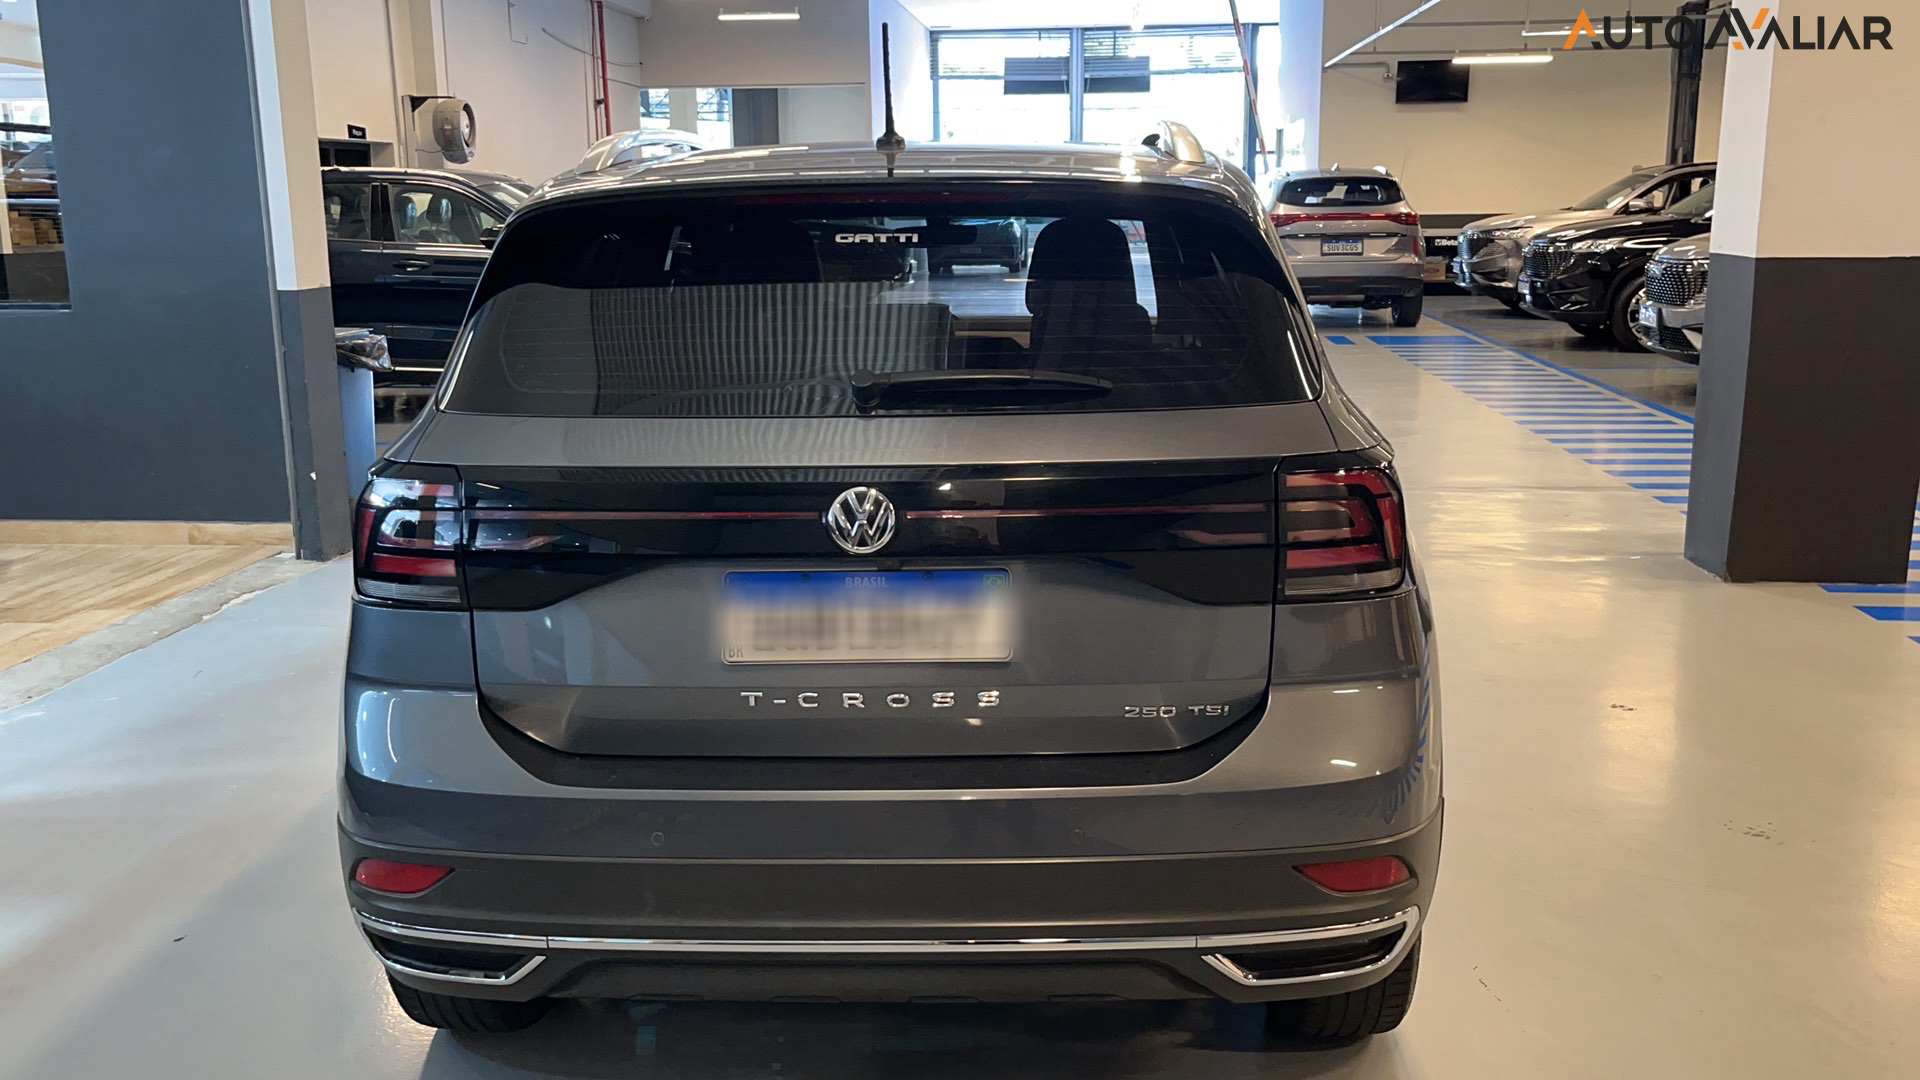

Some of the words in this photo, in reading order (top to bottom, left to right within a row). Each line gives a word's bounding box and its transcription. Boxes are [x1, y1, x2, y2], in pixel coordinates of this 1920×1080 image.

[835, 233, 919, 243] GATTI
[845, 576, 889, 588] BRASIL
[728, 645, 744, 658] BR
[740, 690, 1000, 708] T-CROSS
[1124, 706, 1176, 718] 250
[1187, 705, 1230, 716] TSI
